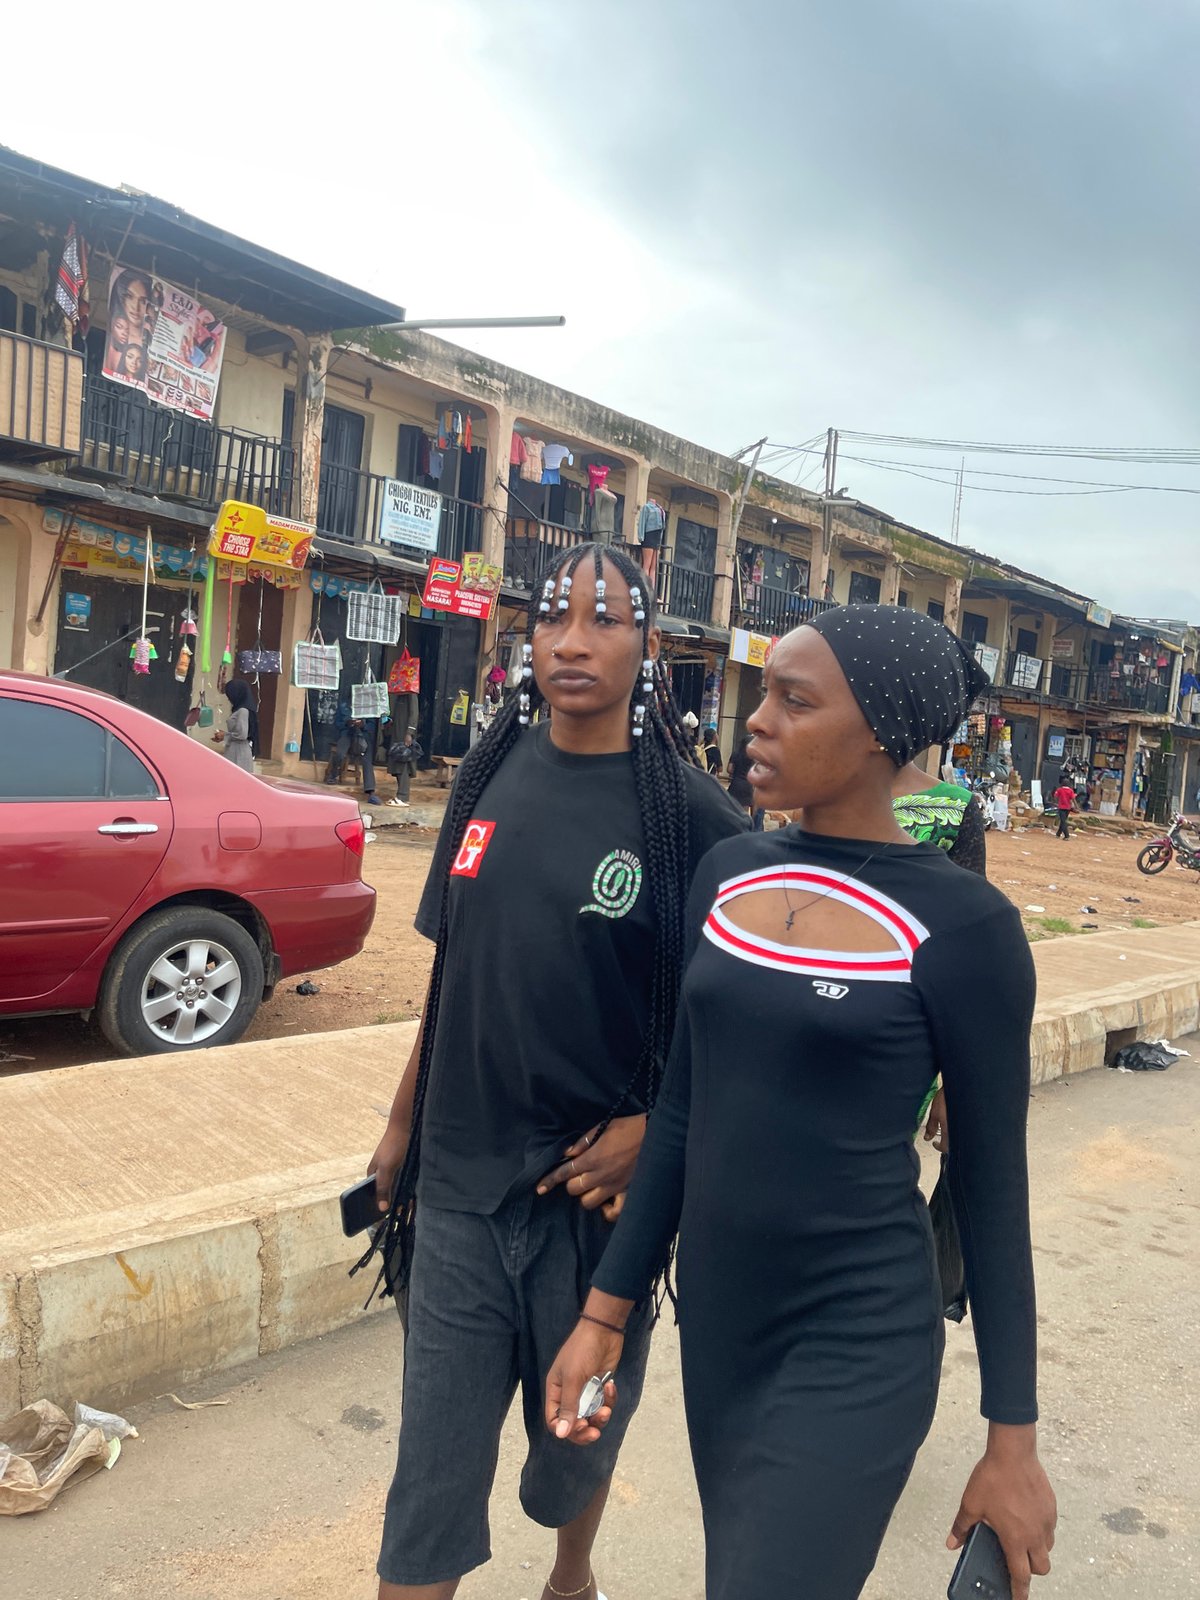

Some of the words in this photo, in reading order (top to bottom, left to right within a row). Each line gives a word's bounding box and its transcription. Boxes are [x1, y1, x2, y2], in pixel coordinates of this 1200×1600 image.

[413, 490, 438, 509] TEXTILES
[393, 499, 411, 515] NIG.
[414, 505, 432, 520] ENT.
[269, 520, 290, 530] MADAM
[234, 545, 249, 557] STAR
[613, 848, 642, 871] AMIRI
